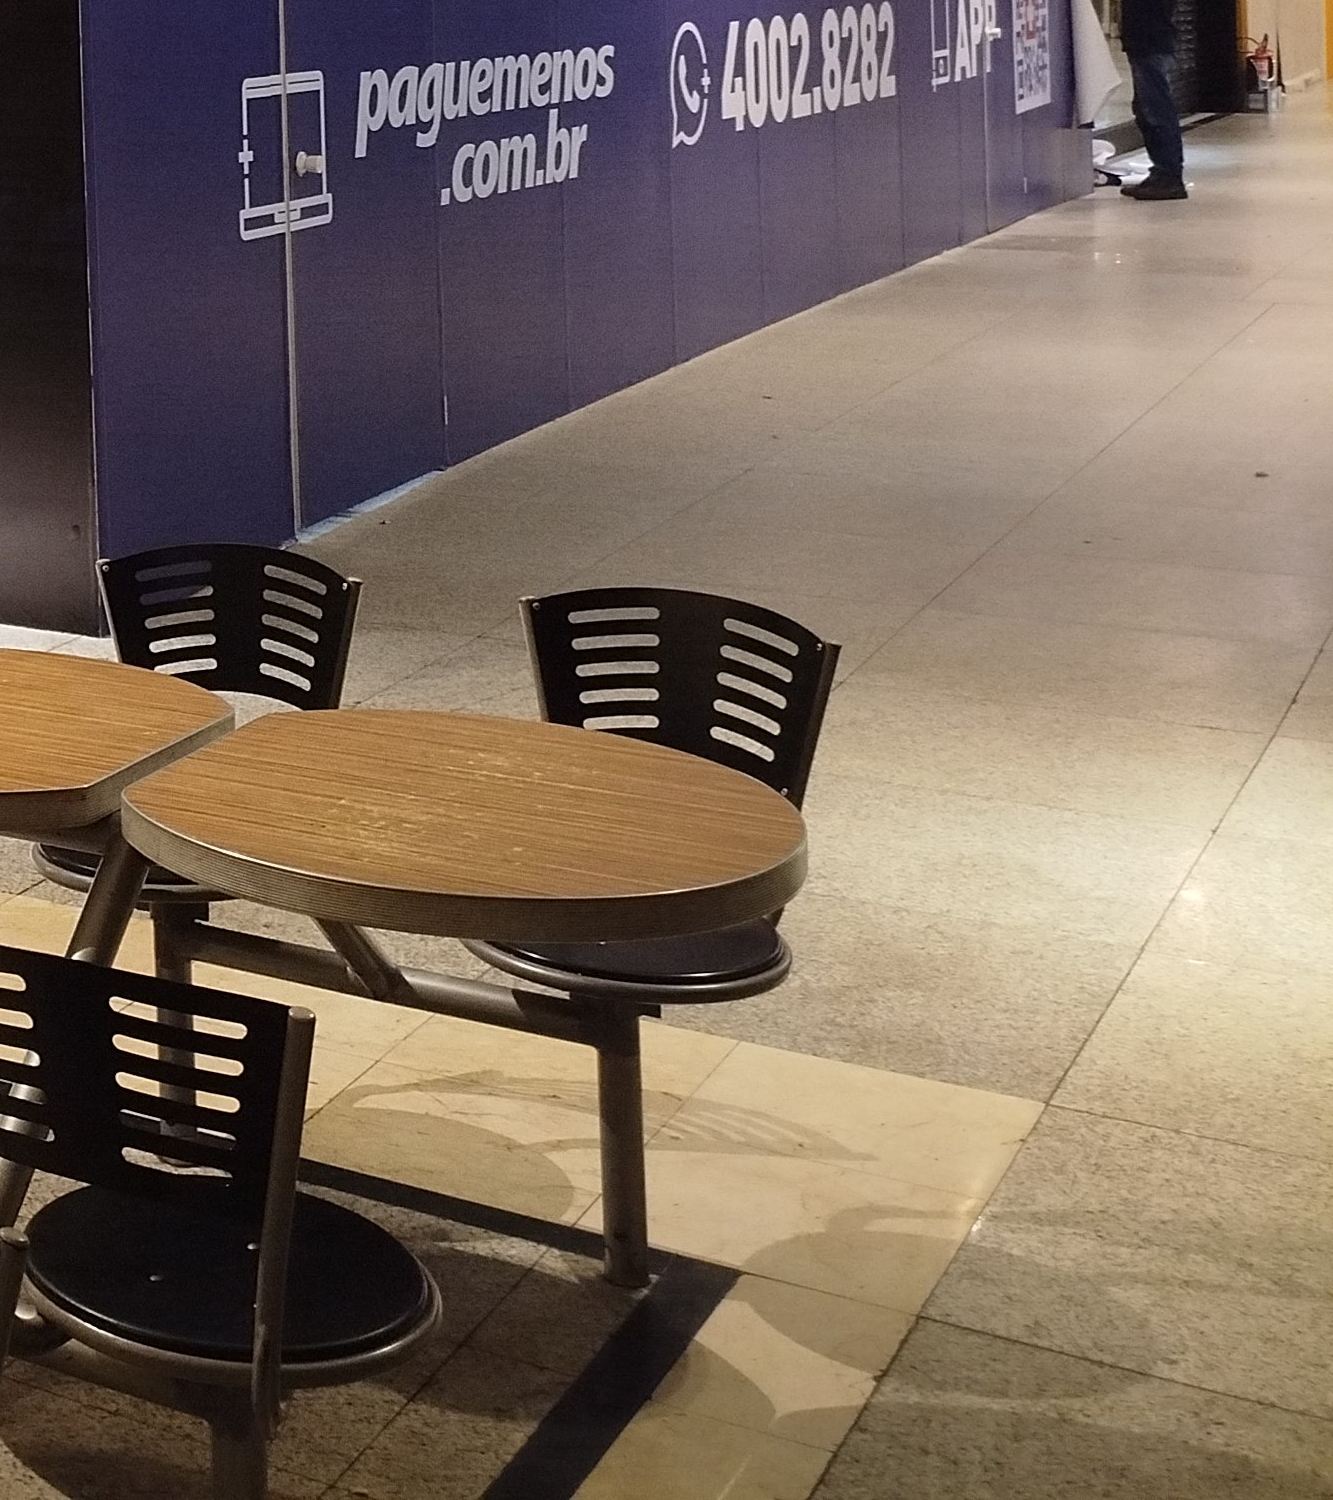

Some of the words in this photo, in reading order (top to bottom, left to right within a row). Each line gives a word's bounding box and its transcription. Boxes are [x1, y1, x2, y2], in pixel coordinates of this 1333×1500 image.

[354, 44, 615, 159] paguemenos
[721, 0, 897, 132] 4002.8282
[440, 108, 588, 206] .com.br
